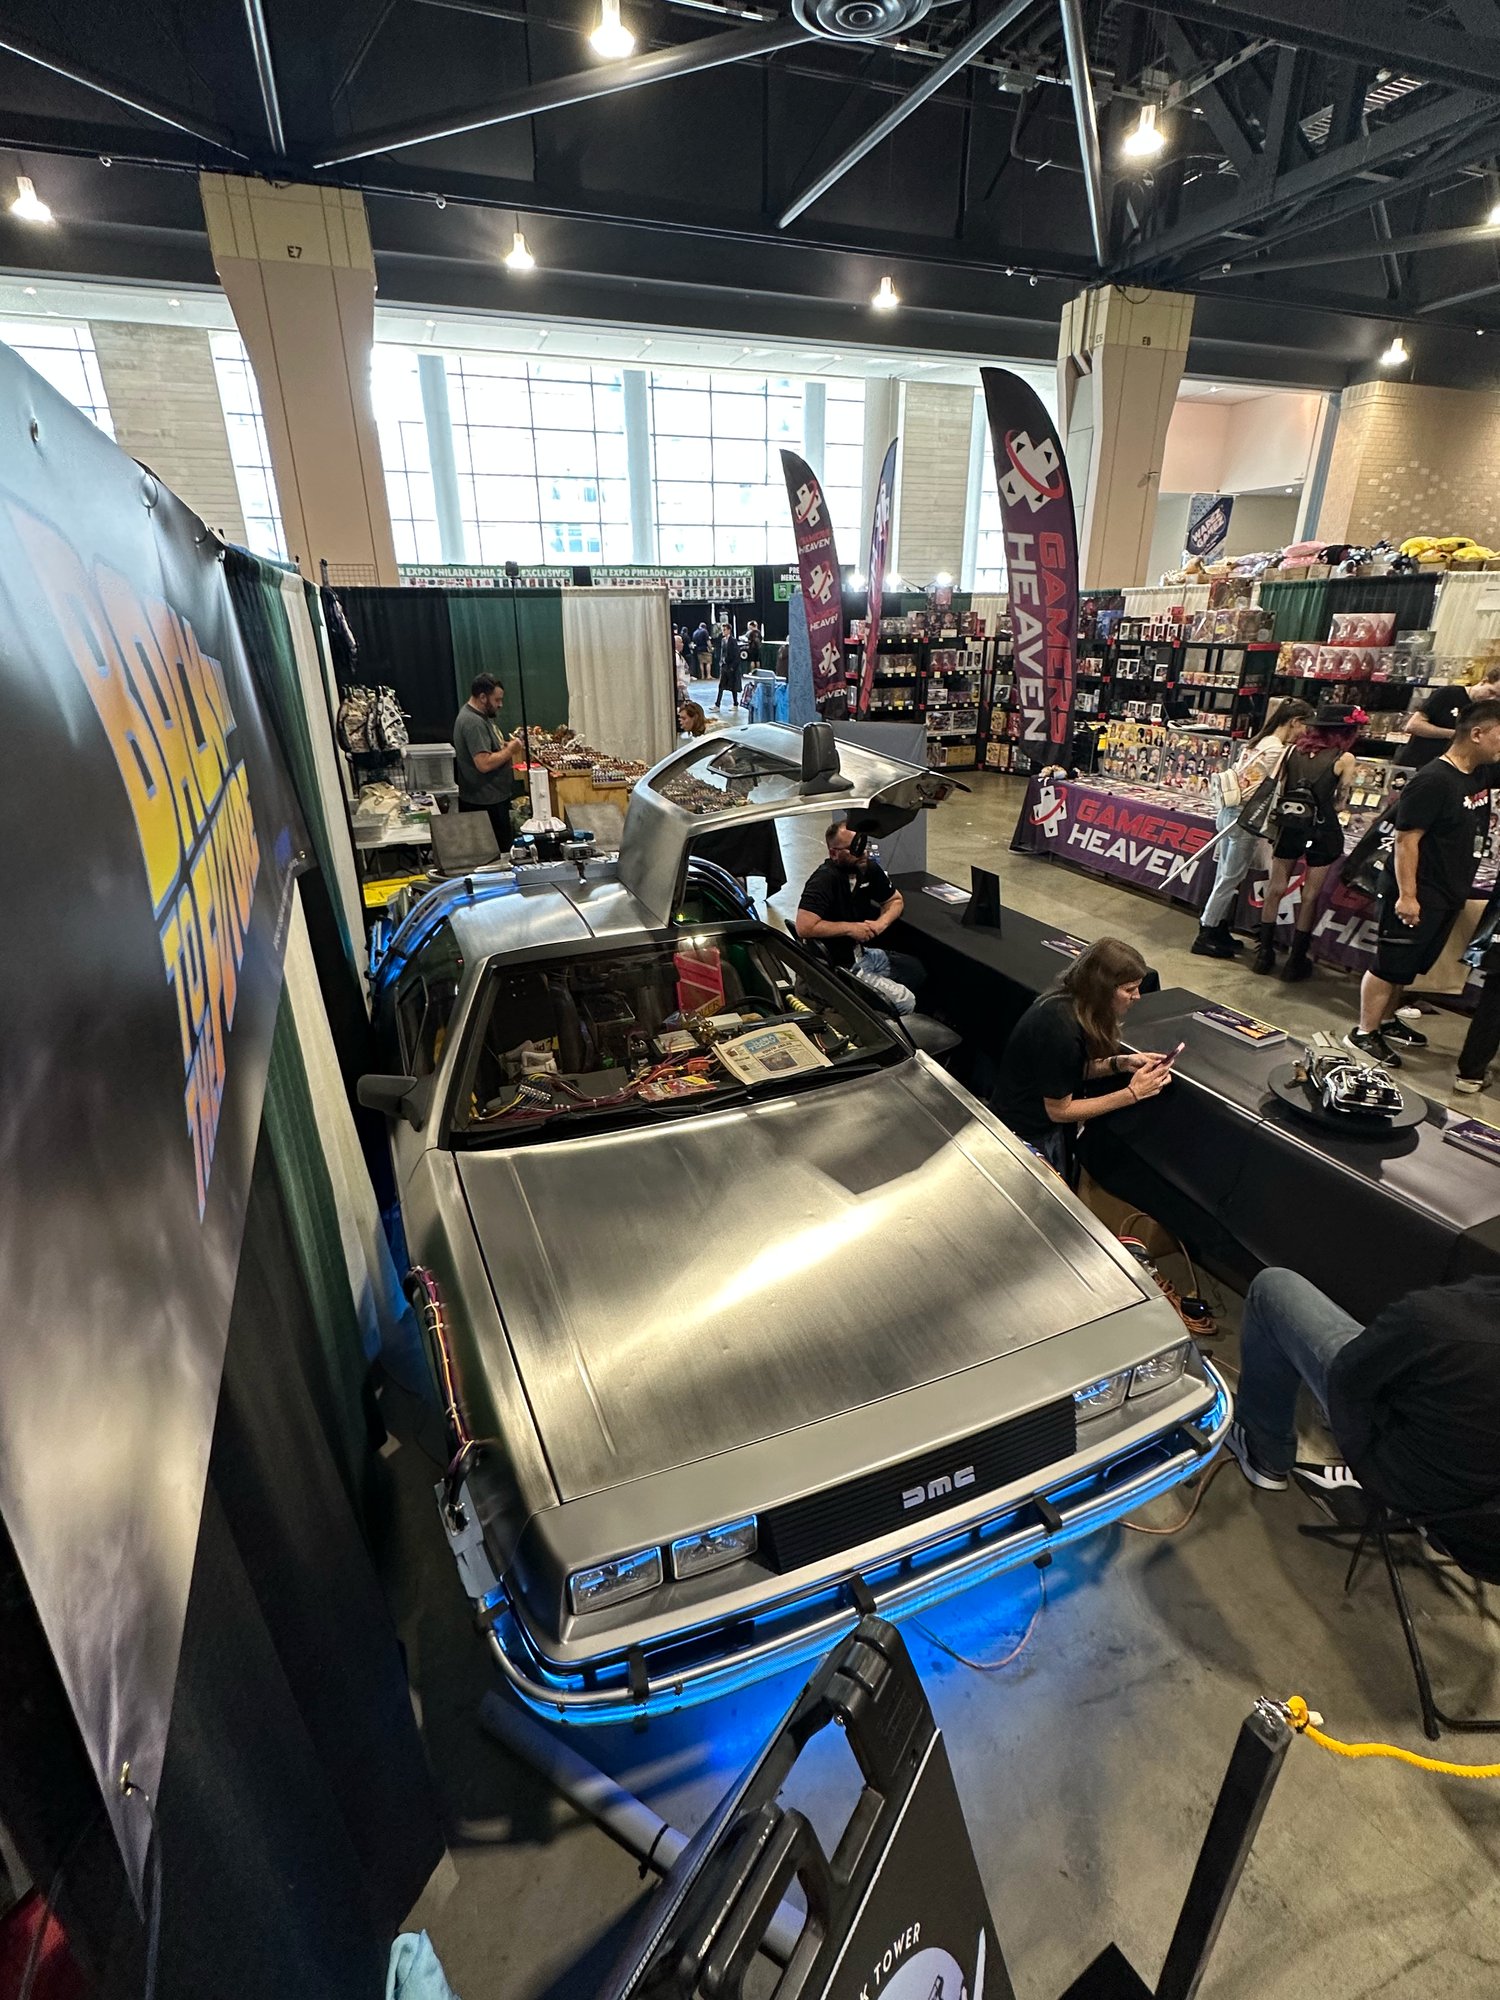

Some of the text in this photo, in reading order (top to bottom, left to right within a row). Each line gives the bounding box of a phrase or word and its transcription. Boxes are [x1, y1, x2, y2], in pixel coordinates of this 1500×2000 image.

[287, 245, 302, 259] E7
[406, 567, 430, 577] EXPO
[432, 567, 496, 577] PHILADELPHIA
[521, 567, 571, 577] EXCLUSIVES
[609, 569, 630, 577] EXPO
[632, 568, 687, 578] PHILADELPHIA
[688, 569, 708, 577] 2023
[709, 567, 752, 577] EXCLUSIVES
[799, 537, 830, 554] HEAVEN
[780, 574, 801, 582] MERCH
[1008, 532, 1047, 742] HEAVEN
[1039, 531, 1073, 744] GAMERS
[3, 491, 231, 921] BACK
[1067, 823, 1200, 885] HEAVEN
[1076, 798, 1214, 854] GAMERS
[159, 882, 205, 1077] TO
[189, 757, 260, 1107] FUTURE
[873, 1921, 921, 1985] TOWER
